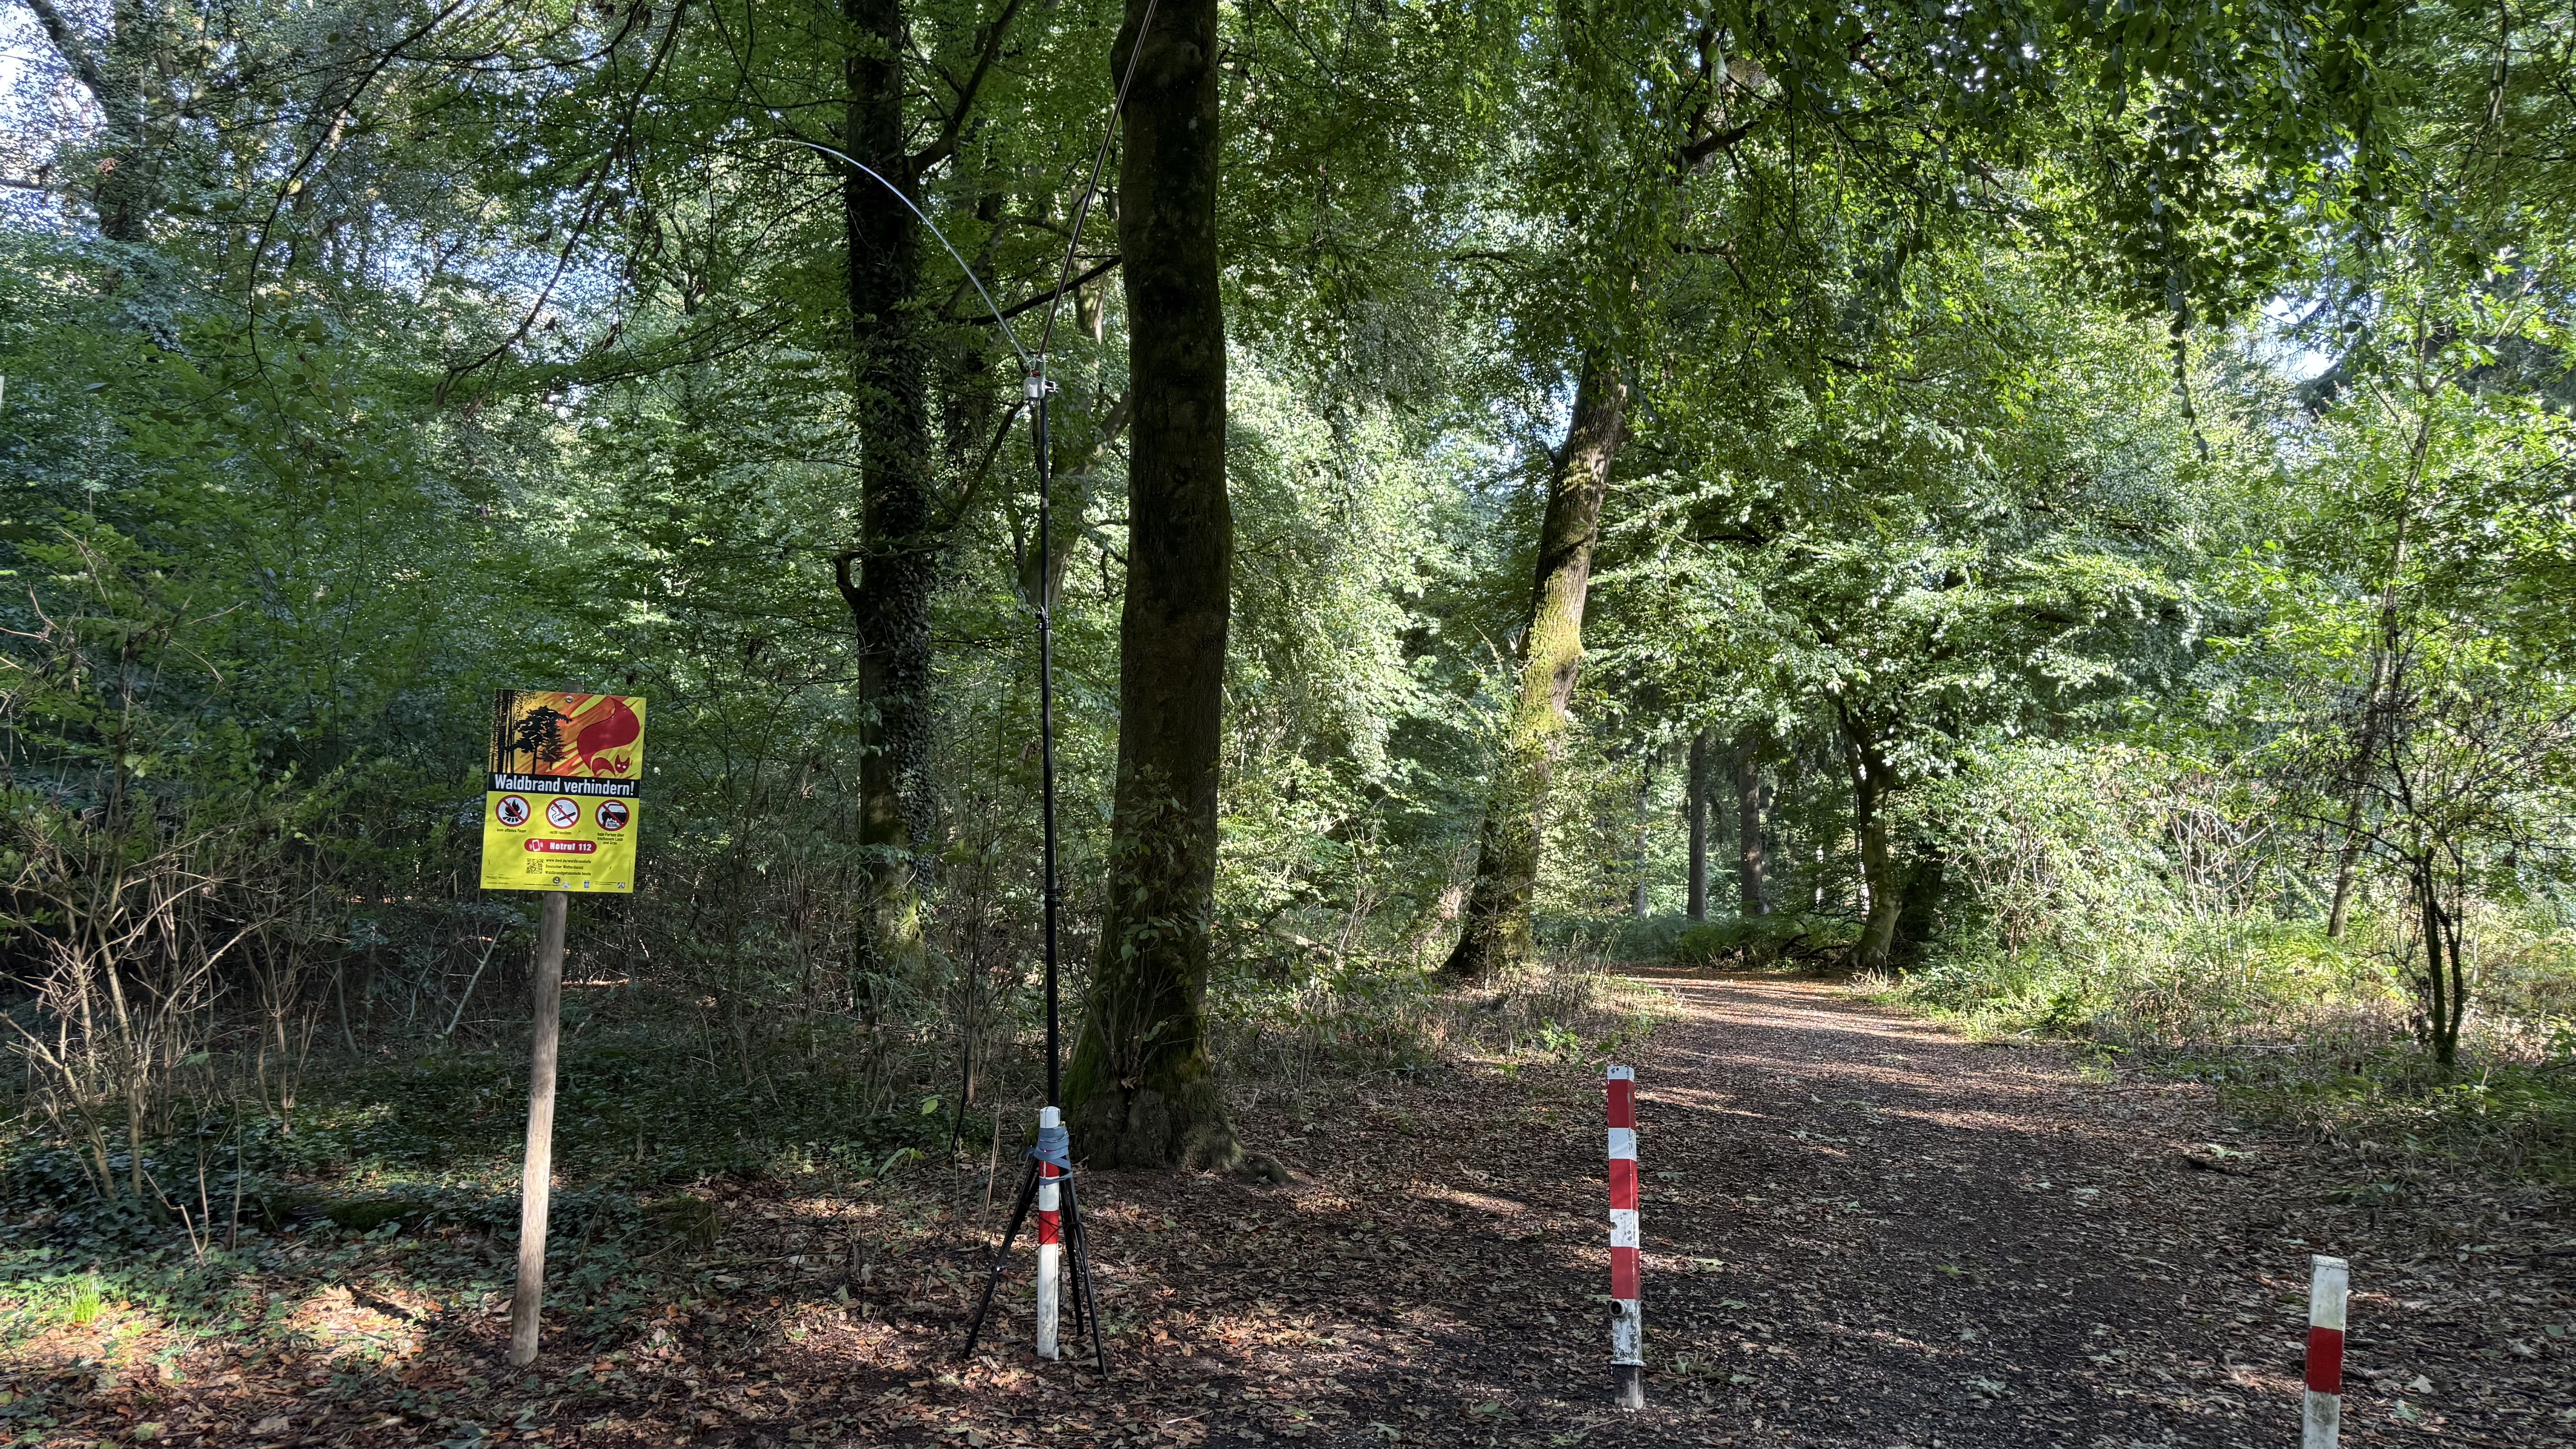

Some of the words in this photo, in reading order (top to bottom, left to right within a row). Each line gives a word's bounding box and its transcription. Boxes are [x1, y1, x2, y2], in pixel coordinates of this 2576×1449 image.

[495, 774, 561, 792] Waldbrand
[564, 779, 635, 796] verhindern!
[550, 842, 576, 851] Notruf
